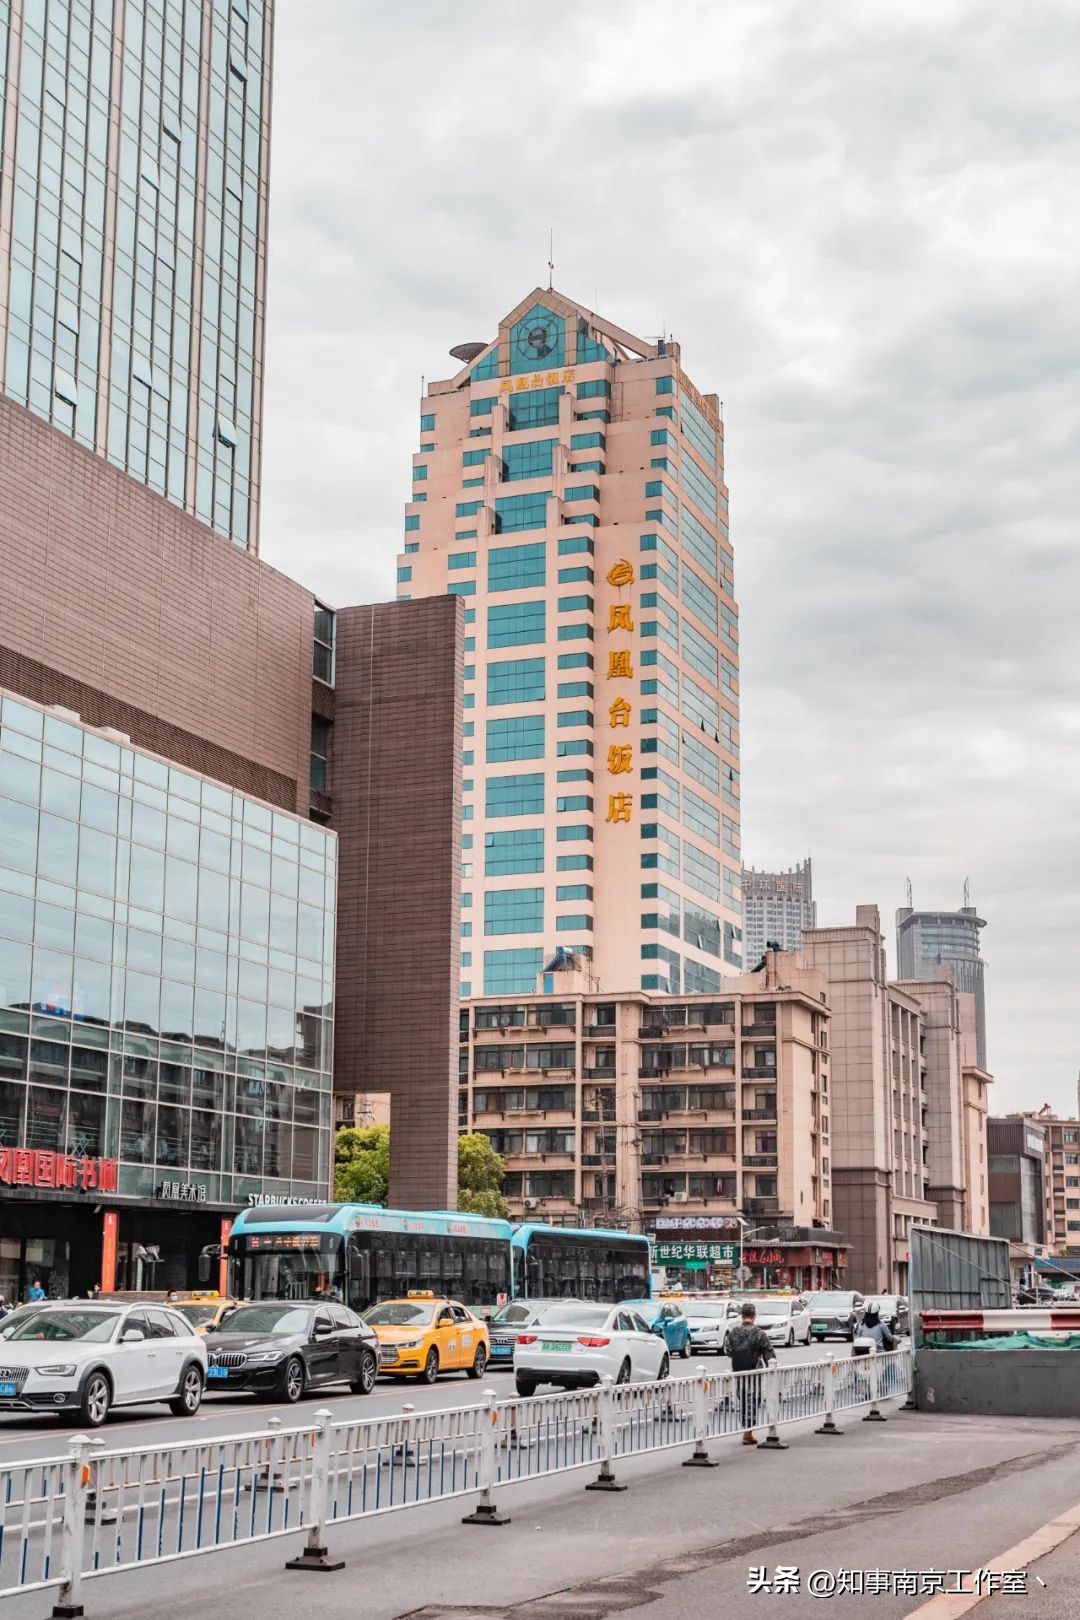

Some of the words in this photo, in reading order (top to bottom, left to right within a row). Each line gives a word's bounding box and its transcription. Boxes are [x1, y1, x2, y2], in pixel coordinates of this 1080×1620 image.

[606, 604, 634, 823] 凤凰台饭店
[741, 879, 804, 896] 中环国际
[162, 1181, 207, 1202] 凤凰美术馆
[248, 1193, 297, 1206] STARBUCKS
[650, 1244, 734, 1259] 新世纪华联超市
